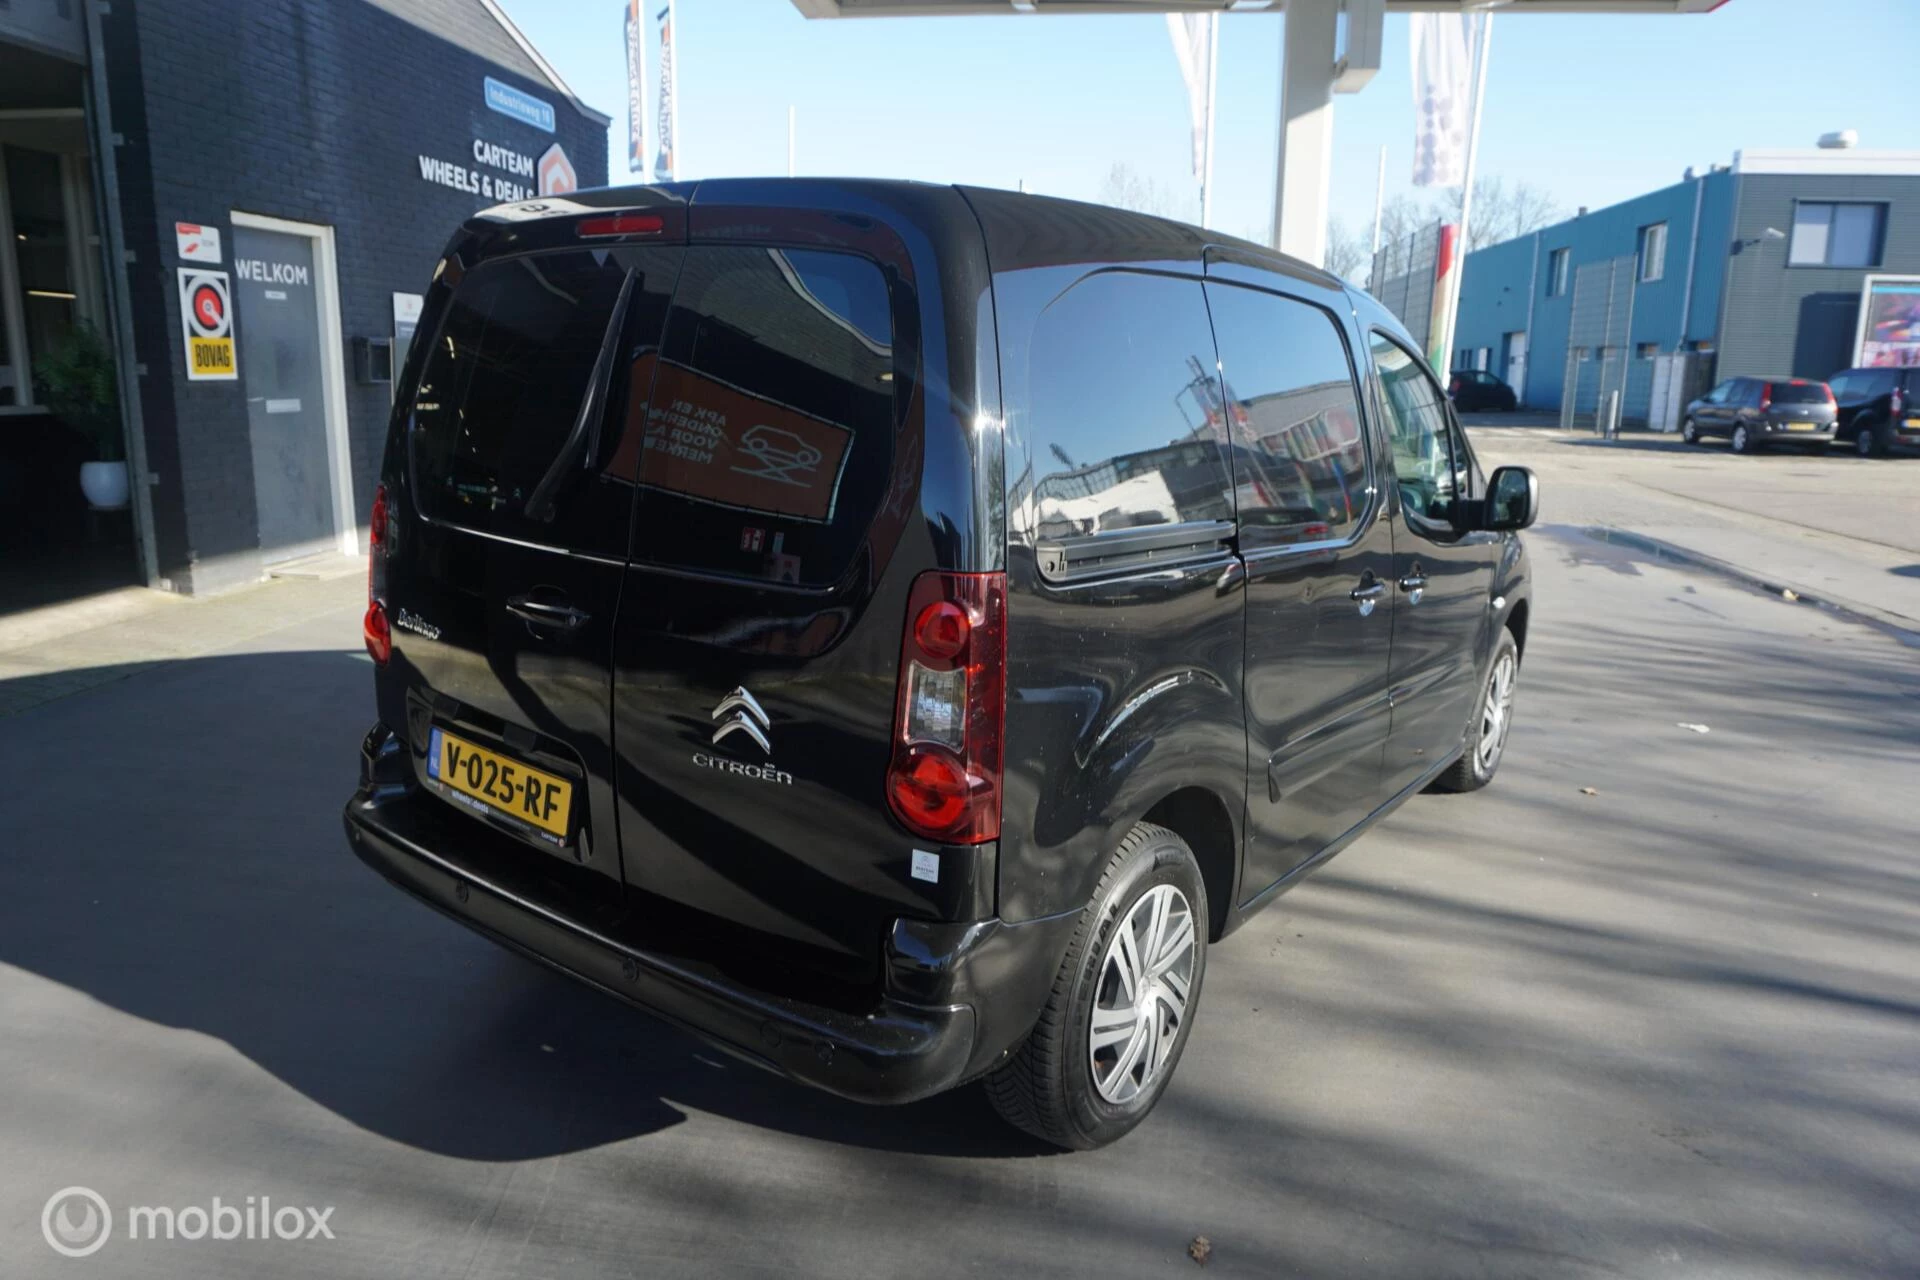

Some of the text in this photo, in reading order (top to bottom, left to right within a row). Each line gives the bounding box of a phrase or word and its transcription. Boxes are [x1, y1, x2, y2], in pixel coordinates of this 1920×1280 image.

[473, 139, 534, 178] CARTEAM
[419, 155, 534, 203] WHEELS & DEALS
[235, 259, 309, 285] WELKOM
[194, 343, 230, 368] BOVAG
[447, 742, 562, 821] V-025-RF
